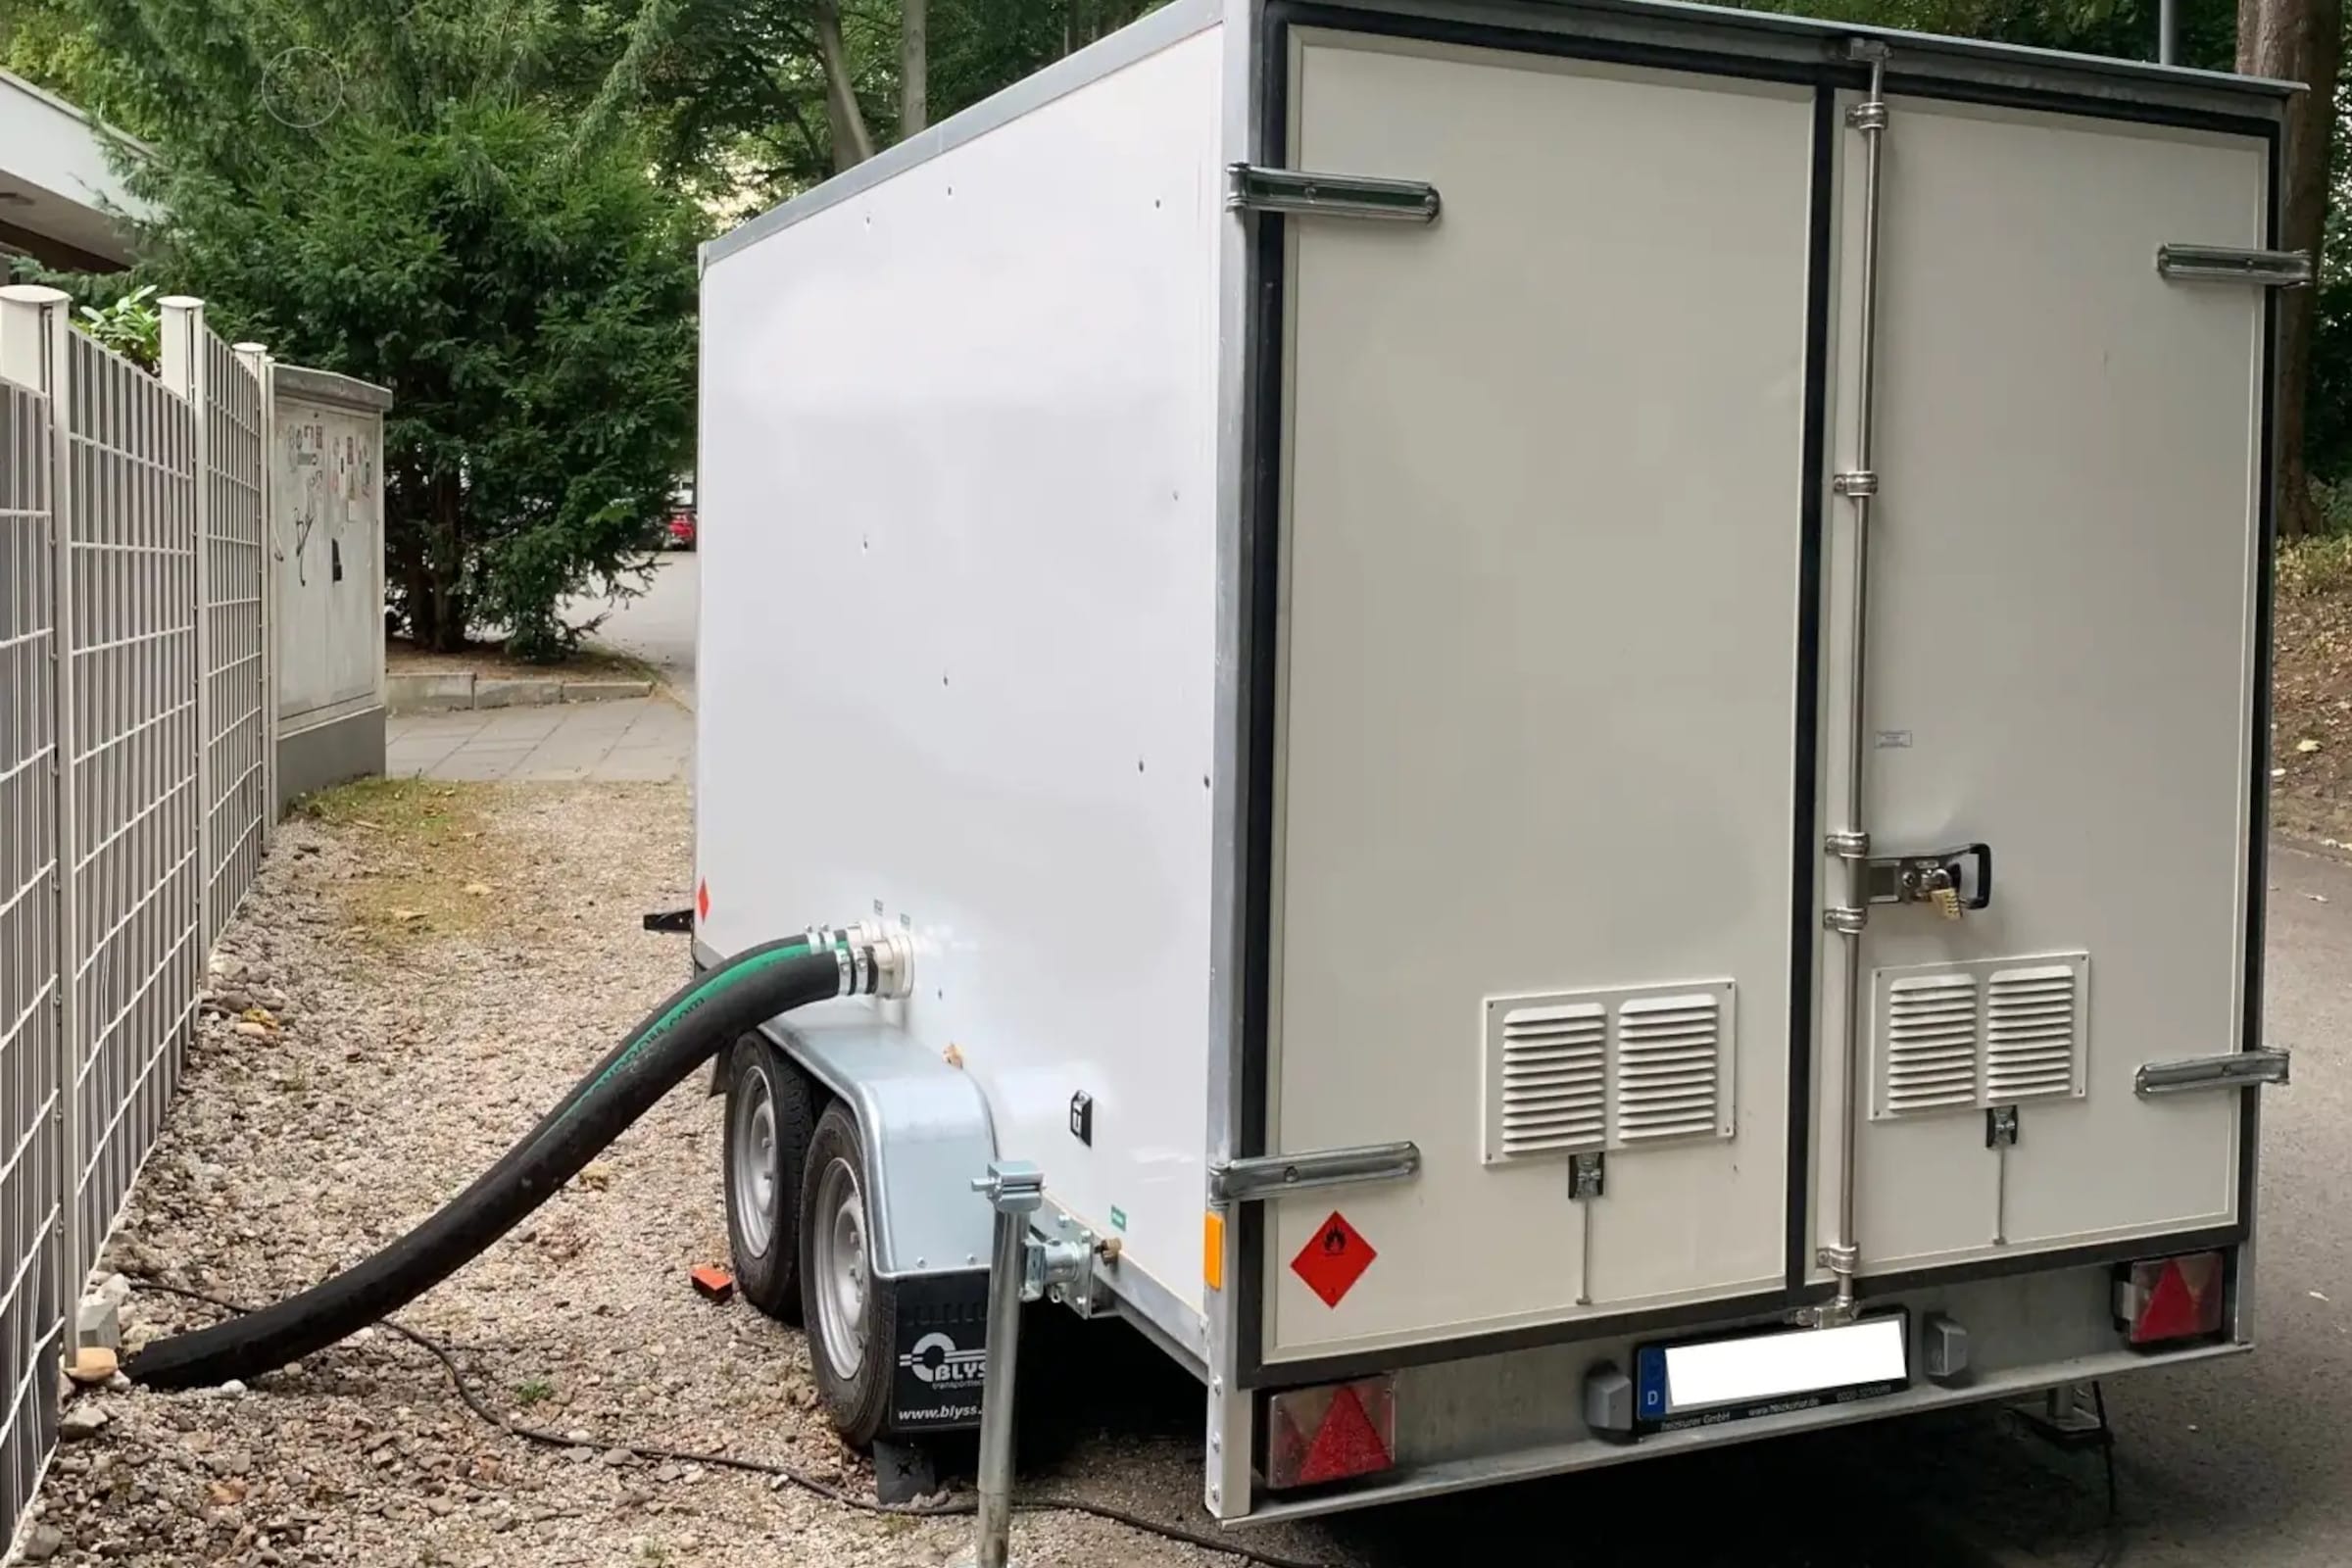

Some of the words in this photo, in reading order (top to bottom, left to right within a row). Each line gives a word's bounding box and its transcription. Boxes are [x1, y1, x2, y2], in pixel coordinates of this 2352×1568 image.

[935, 1361, 987, 1381] BLYS
[1647, 1391, 1658, 1405] D
[899, 1404, 983, 1420] www.blyss.
